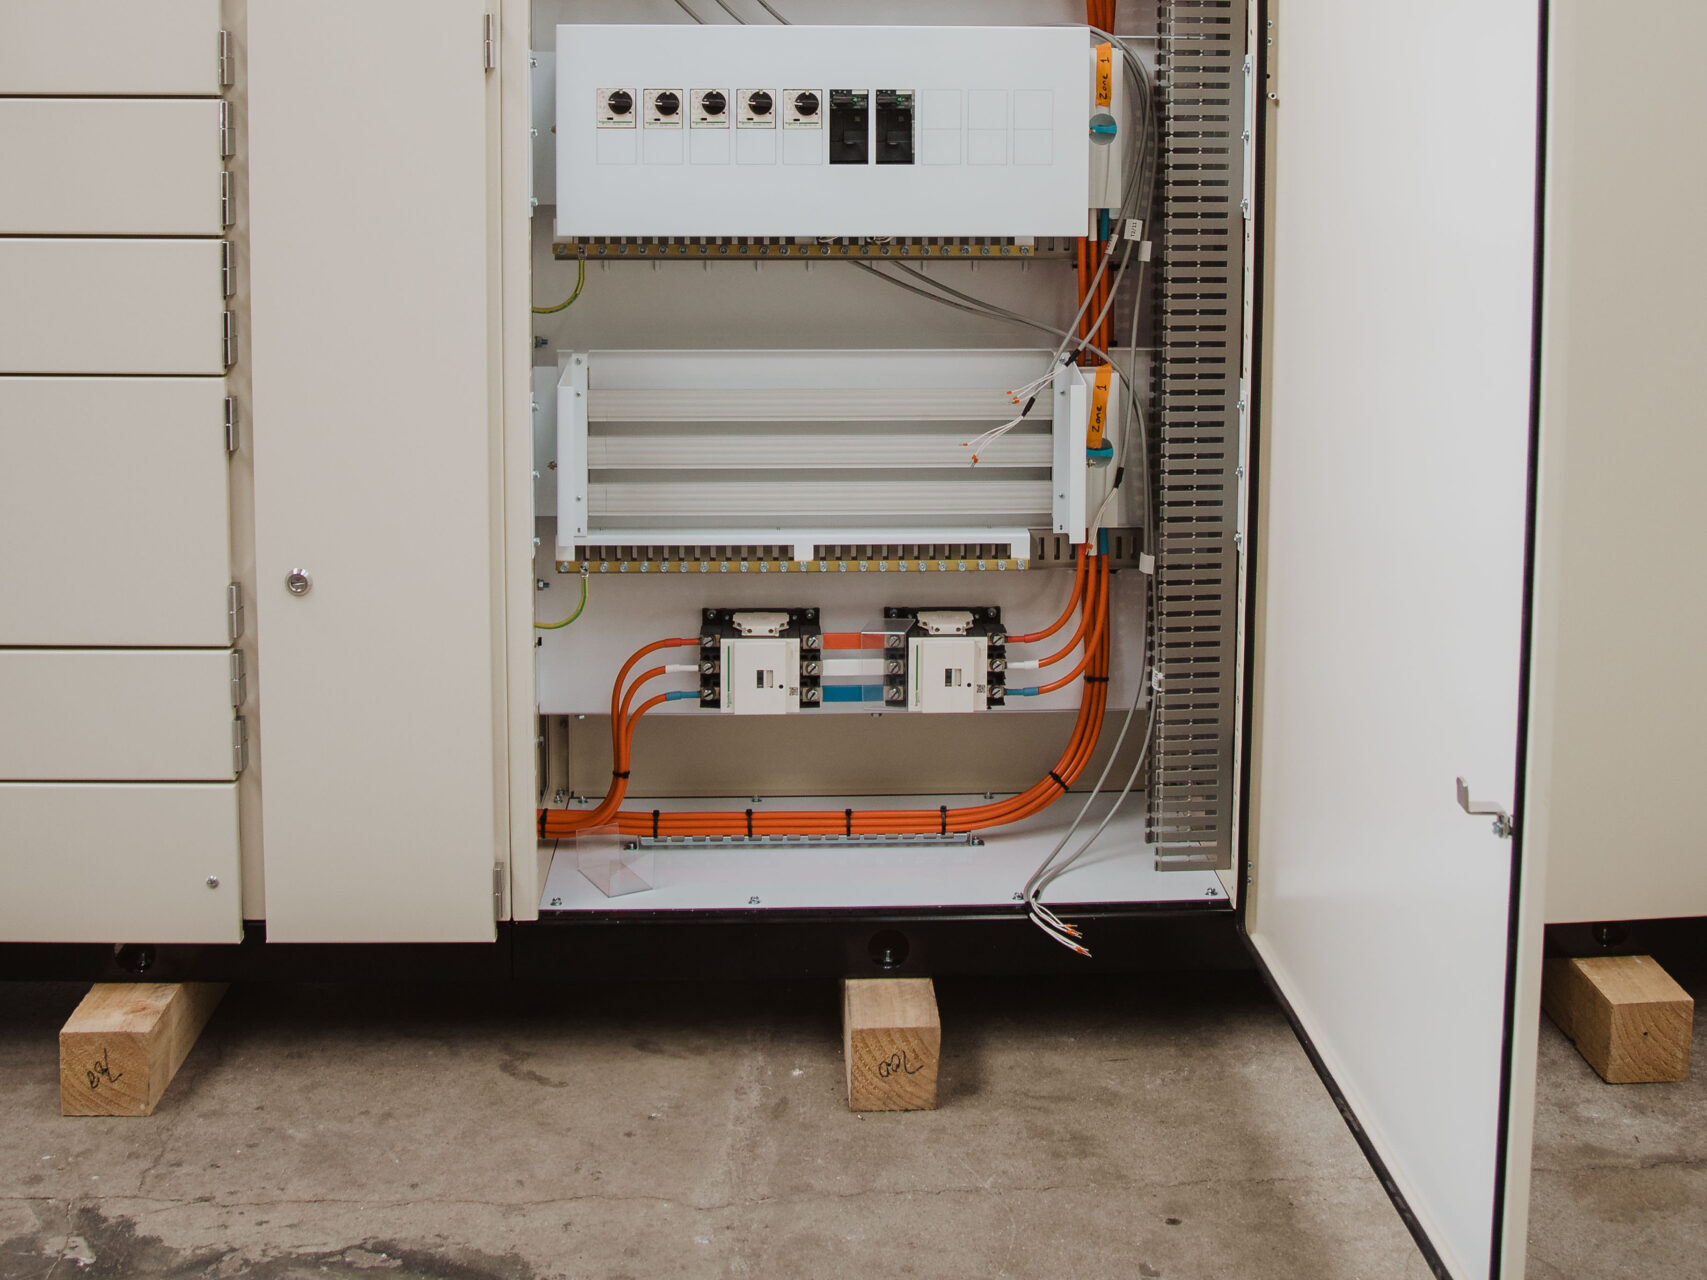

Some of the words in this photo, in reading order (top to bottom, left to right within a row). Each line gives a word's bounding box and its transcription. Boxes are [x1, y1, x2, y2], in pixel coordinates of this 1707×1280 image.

[1099, 73, 1108, 100] Zone
[1096, 384, 1107, 392] 1
[1091, 405, 1103, 433] Zone
